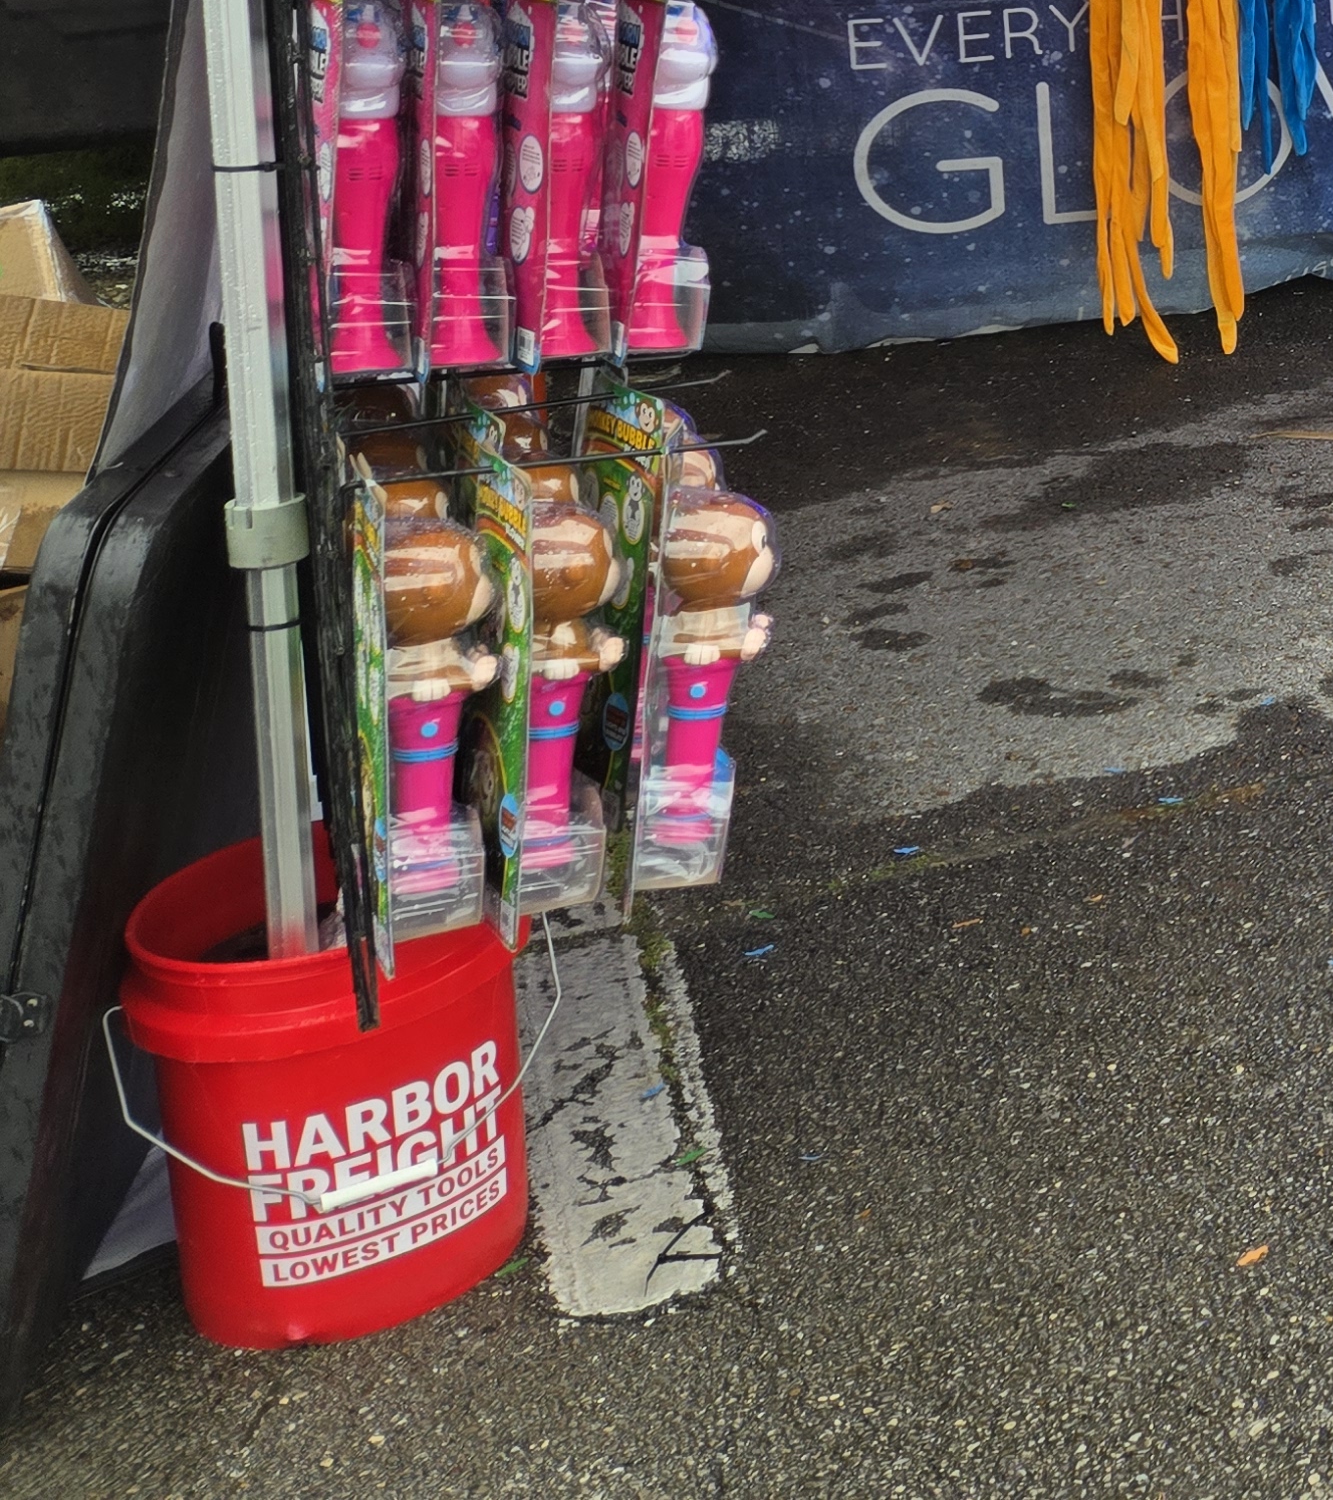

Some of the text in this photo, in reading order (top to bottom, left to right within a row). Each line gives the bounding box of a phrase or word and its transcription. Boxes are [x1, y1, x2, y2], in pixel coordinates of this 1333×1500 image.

[616, 419, 656, 450] BUBBLE
[241, 1039, 499, 1172] HARBOR
[247, 1085, 505, 1223] FREIGHT
[268, 1148, 501, 1251] QUALITY TOOLS
[272, 1180, 501, 1284] LOWEST PRICES
